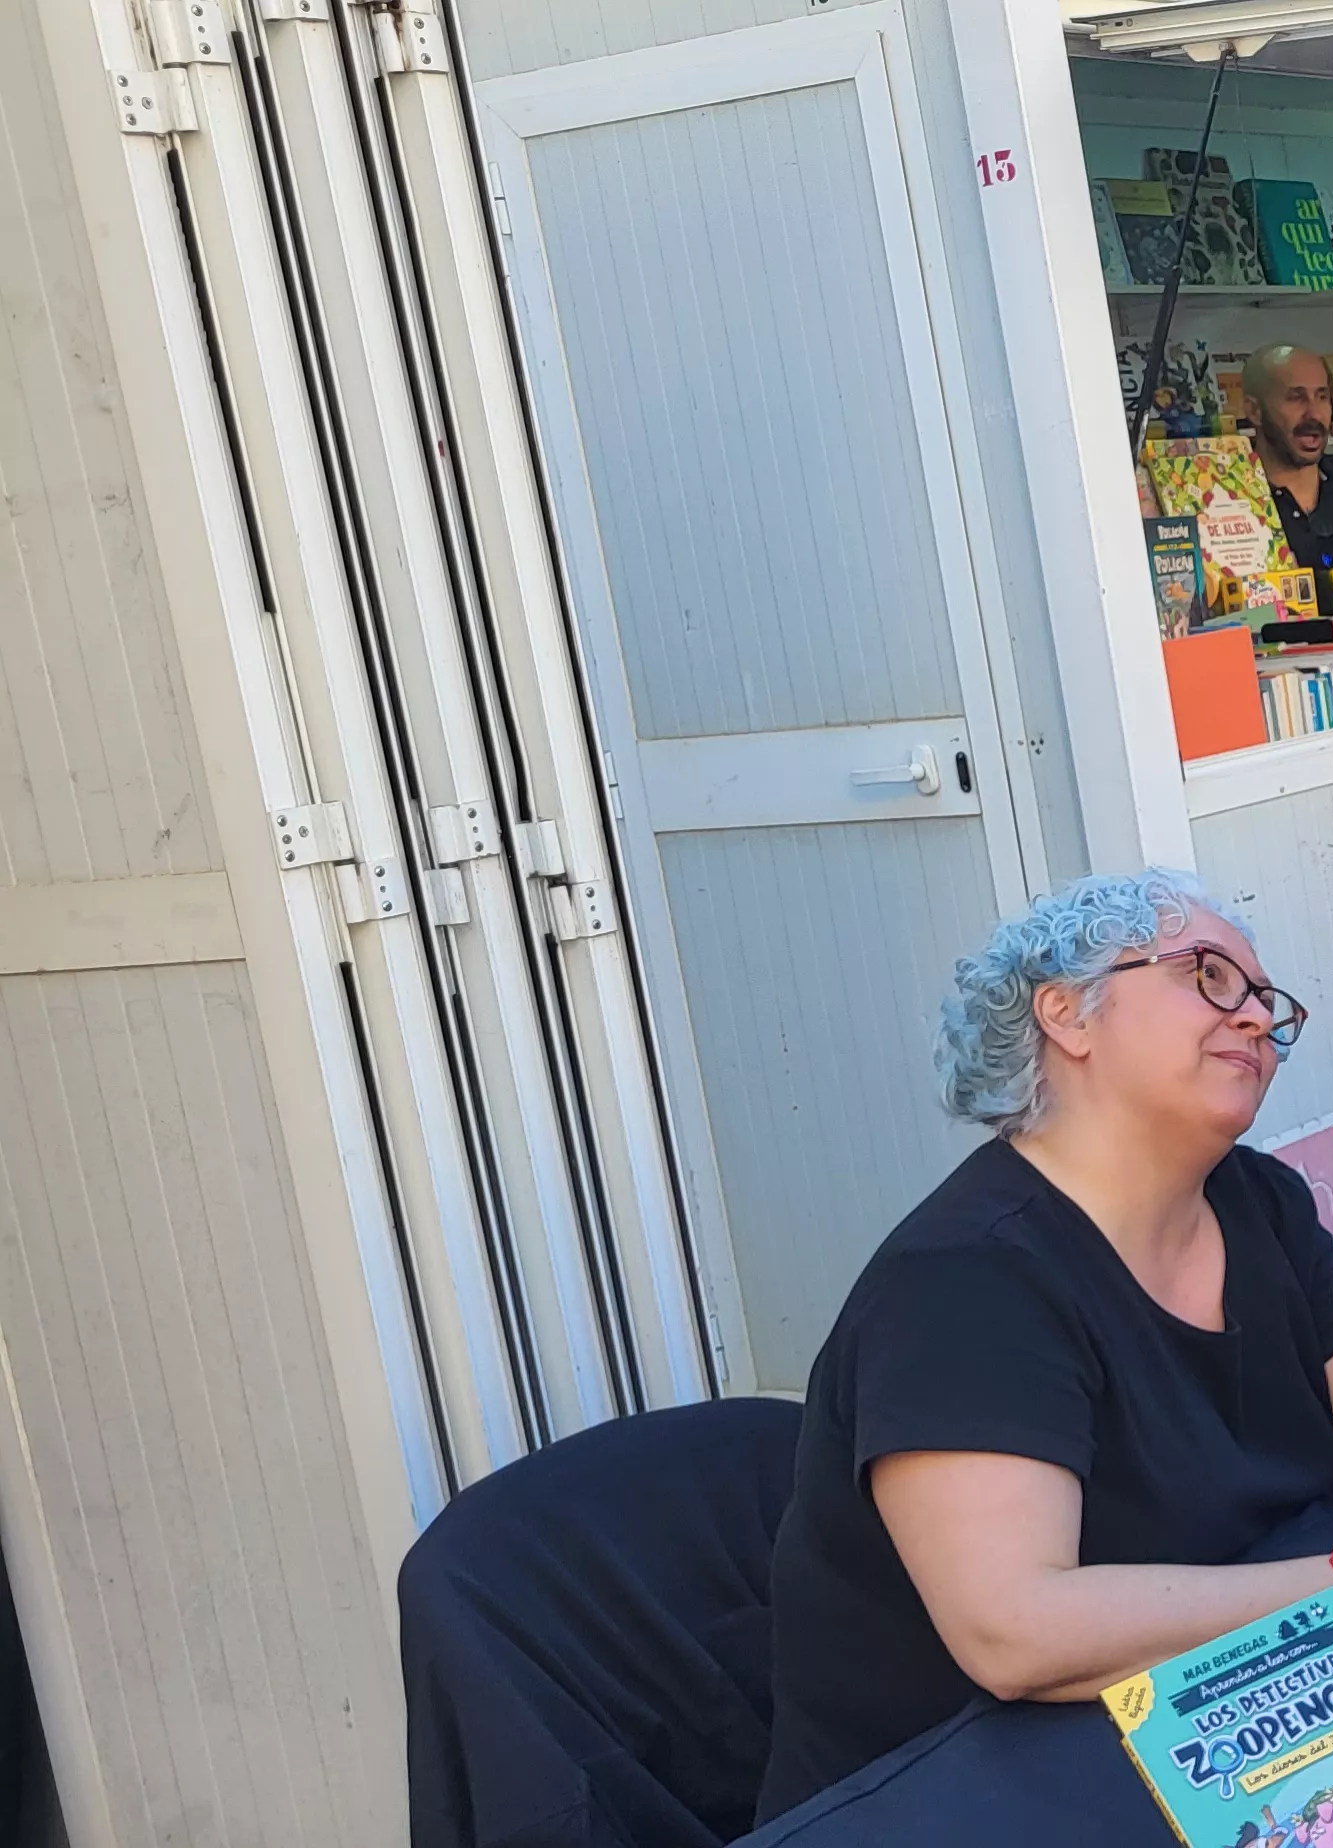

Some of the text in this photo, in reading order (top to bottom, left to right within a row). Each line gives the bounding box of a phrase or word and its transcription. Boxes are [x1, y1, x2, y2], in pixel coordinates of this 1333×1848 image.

[1182, 1635, 1269, 1682] MAR BENEGAS
[1194, 1703, 1238, 1734] LOS
[1245, 1773, 1269, 1786] Los
